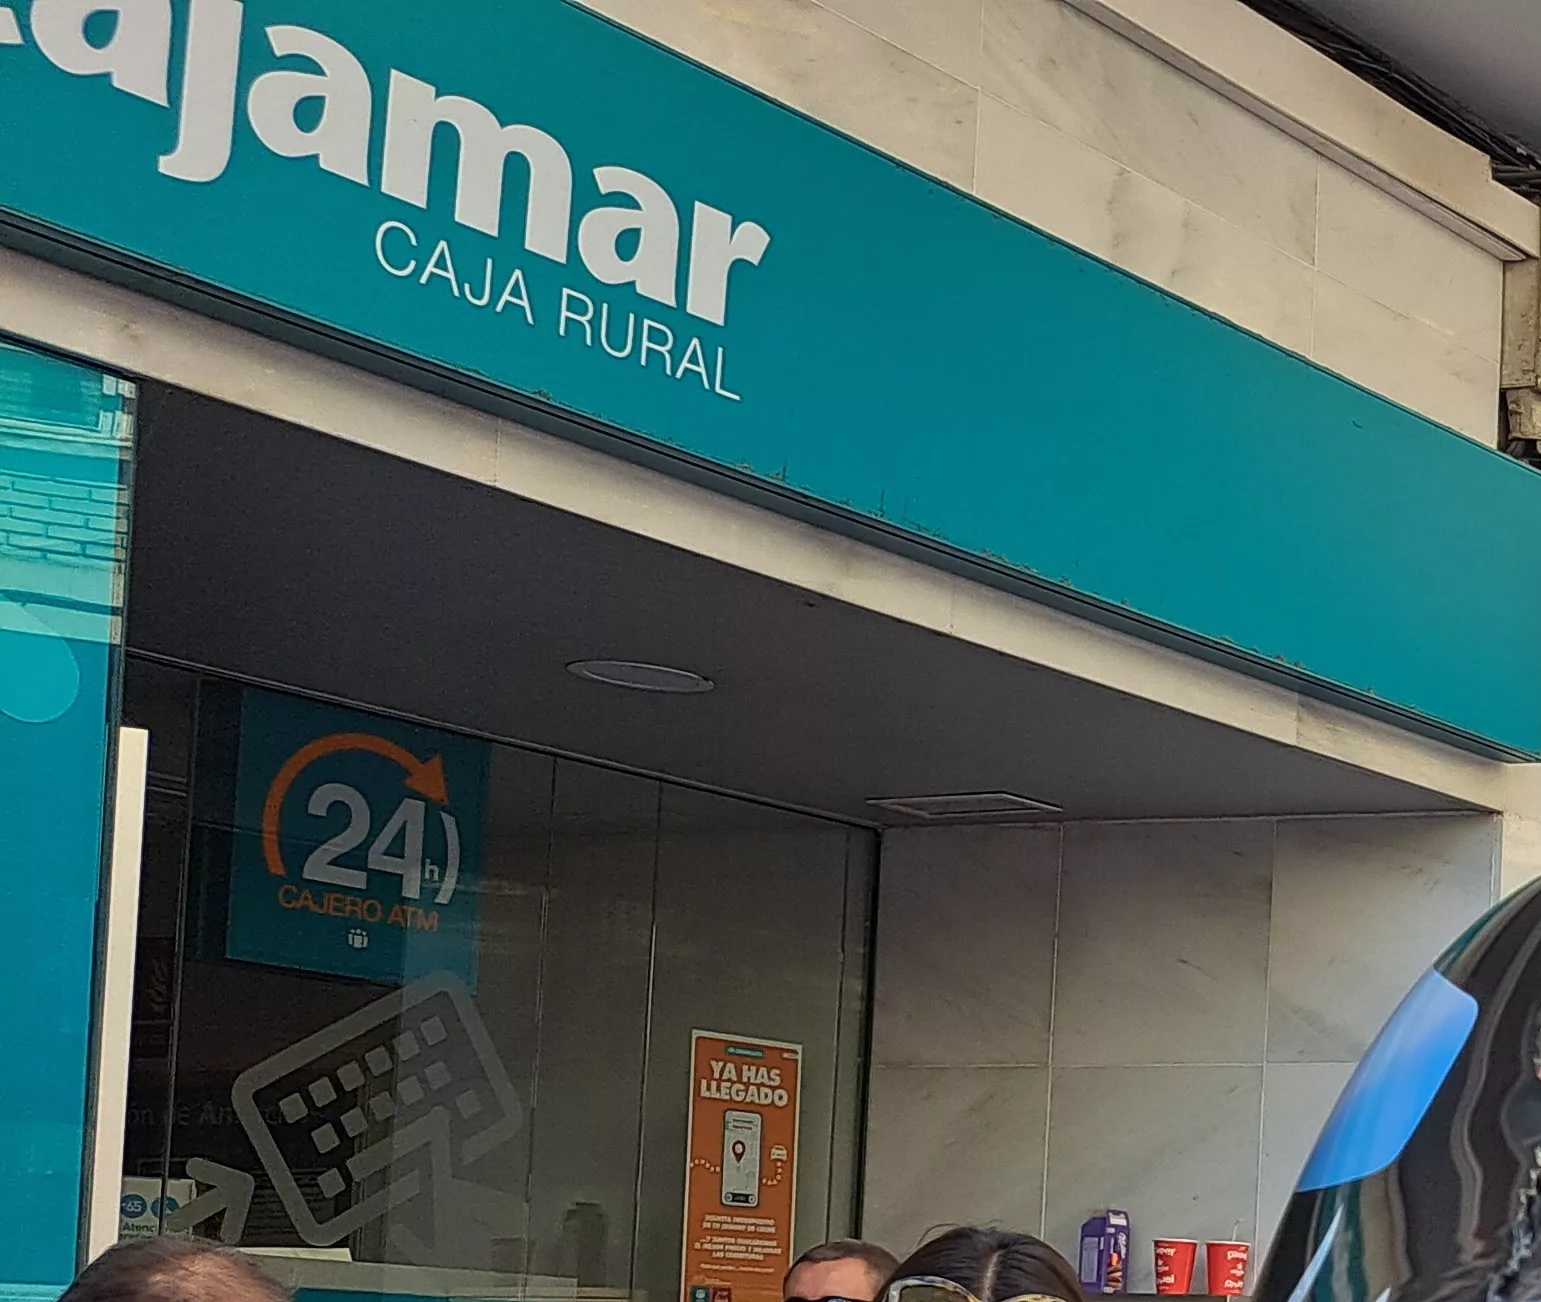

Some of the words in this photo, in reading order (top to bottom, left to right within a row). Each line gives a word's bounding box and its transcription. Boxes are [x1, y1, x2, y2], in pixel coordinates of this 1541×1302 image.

[0, 0, 770, 327] ajamar
[374, 220, 535, 325] CAJA
[558, 287, 742, 401] RURAL
[278, 884, 384, 923] CAJERO
[387, 904, 440, 932] ATM
[700, 1078, 790, 1108] LLEGADO
[709, 1059, 738, 1081] YA
[741, 1064, 782, 1087] HAS
